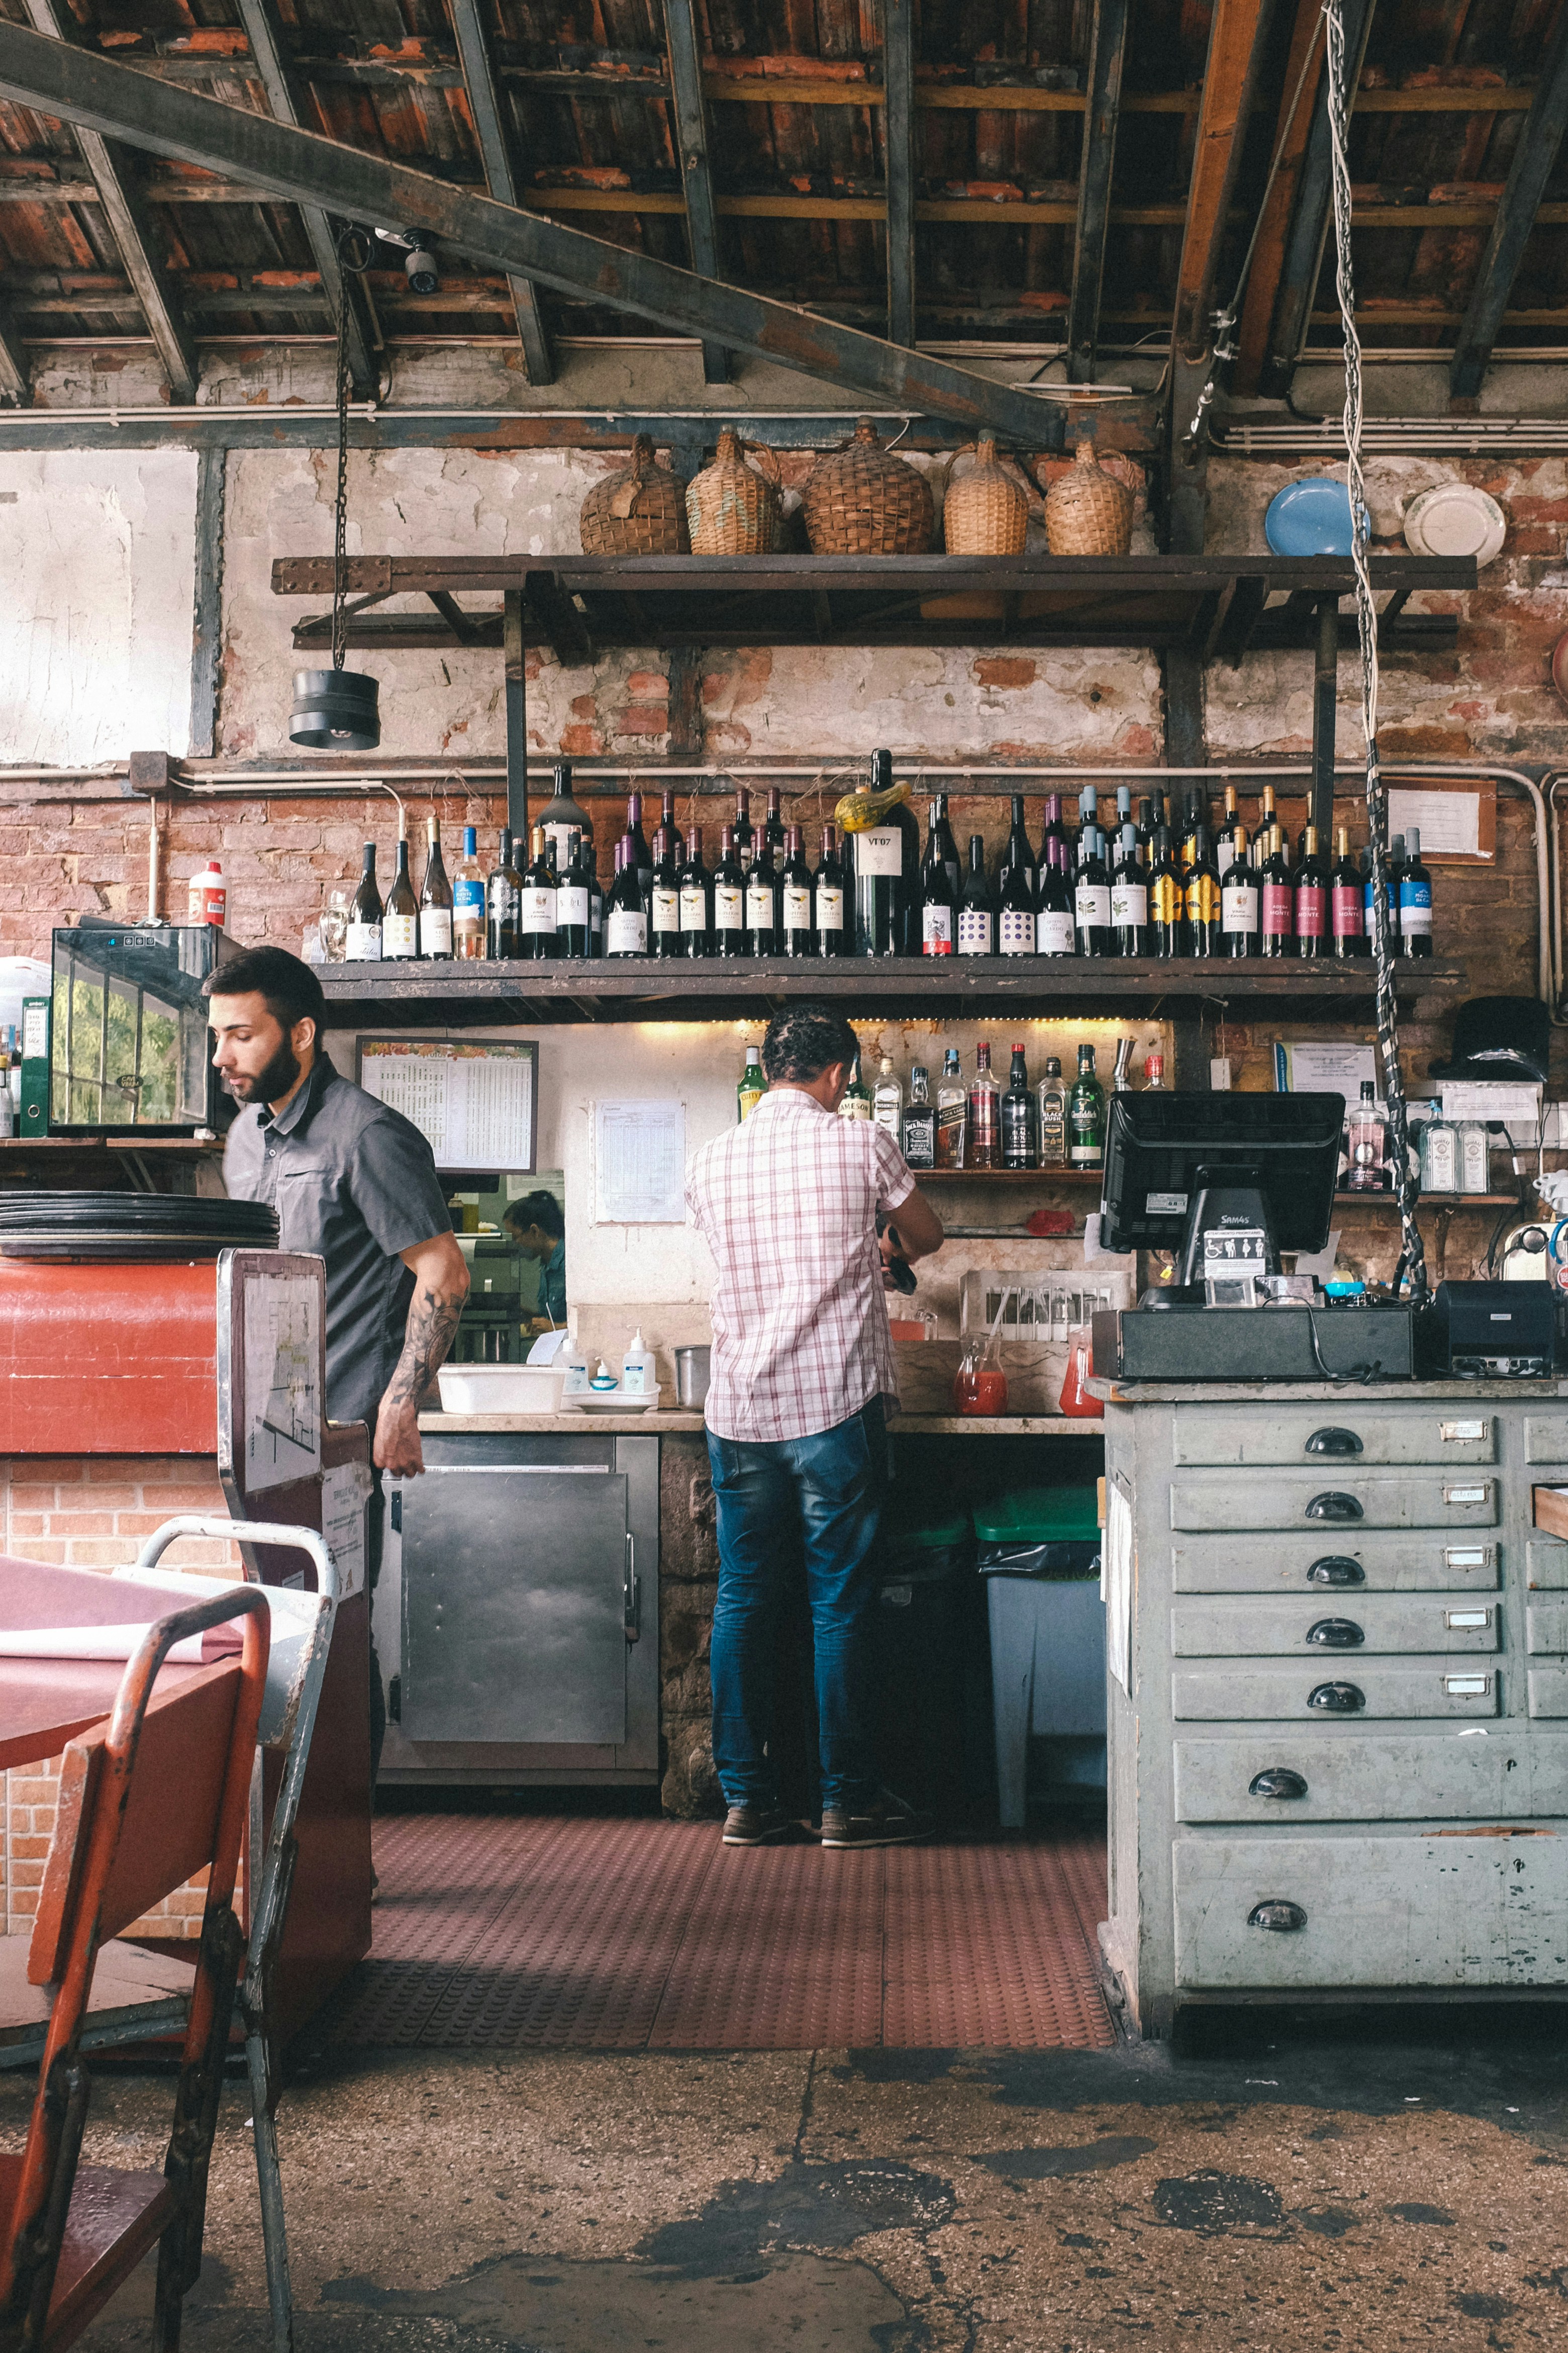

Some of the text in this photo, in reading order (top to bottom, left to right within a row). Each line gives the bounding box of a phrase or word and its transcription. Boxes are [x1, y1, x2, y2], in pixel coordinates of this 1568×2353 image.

[868, 837, 891, 845] VT'07
[838, 1102, 869, 1112] JAMESON
[1071, 1110, 1097, 1119] Glenfiddich
